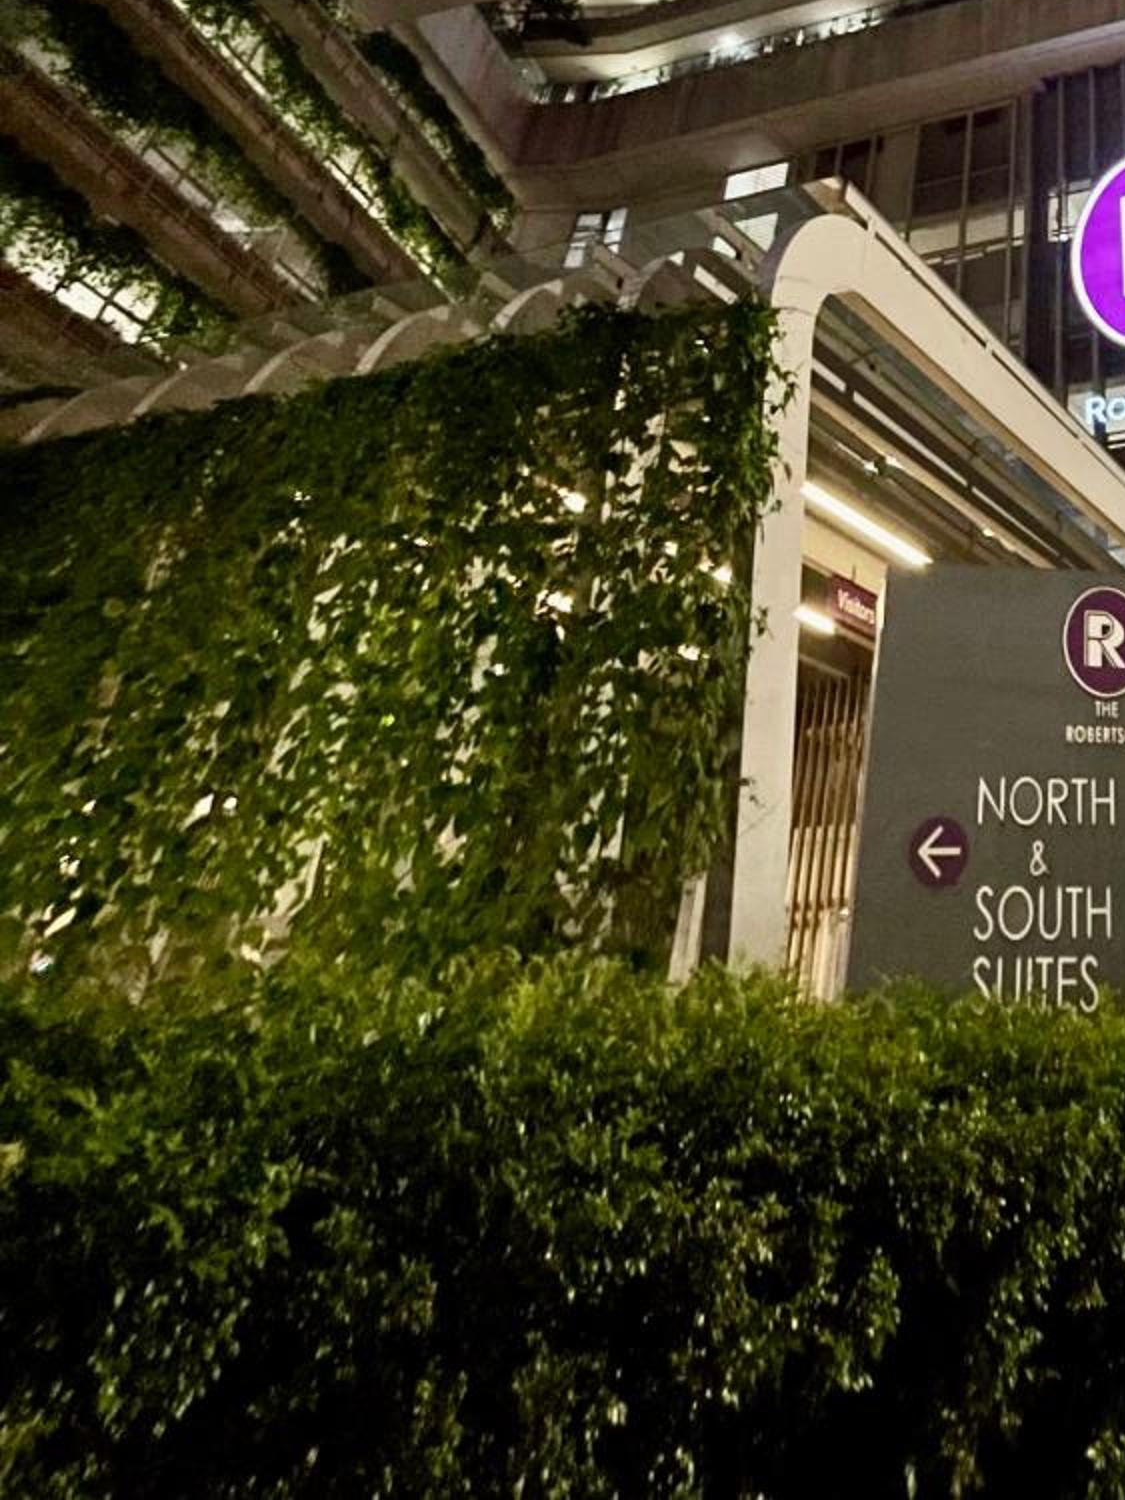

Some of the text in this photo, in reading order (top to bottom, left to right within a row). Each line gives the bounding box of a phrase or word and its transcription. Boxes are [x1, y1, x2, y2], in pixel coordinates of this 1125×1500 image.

[1095, 701, 1120, 719] THE
[977, 775, 1116, 827] NORTH
[1029, 839, 1051, 877] &
[972, 885, 1112, 942] SOUTH
[972, 954, 1100, 1015] SUITES
